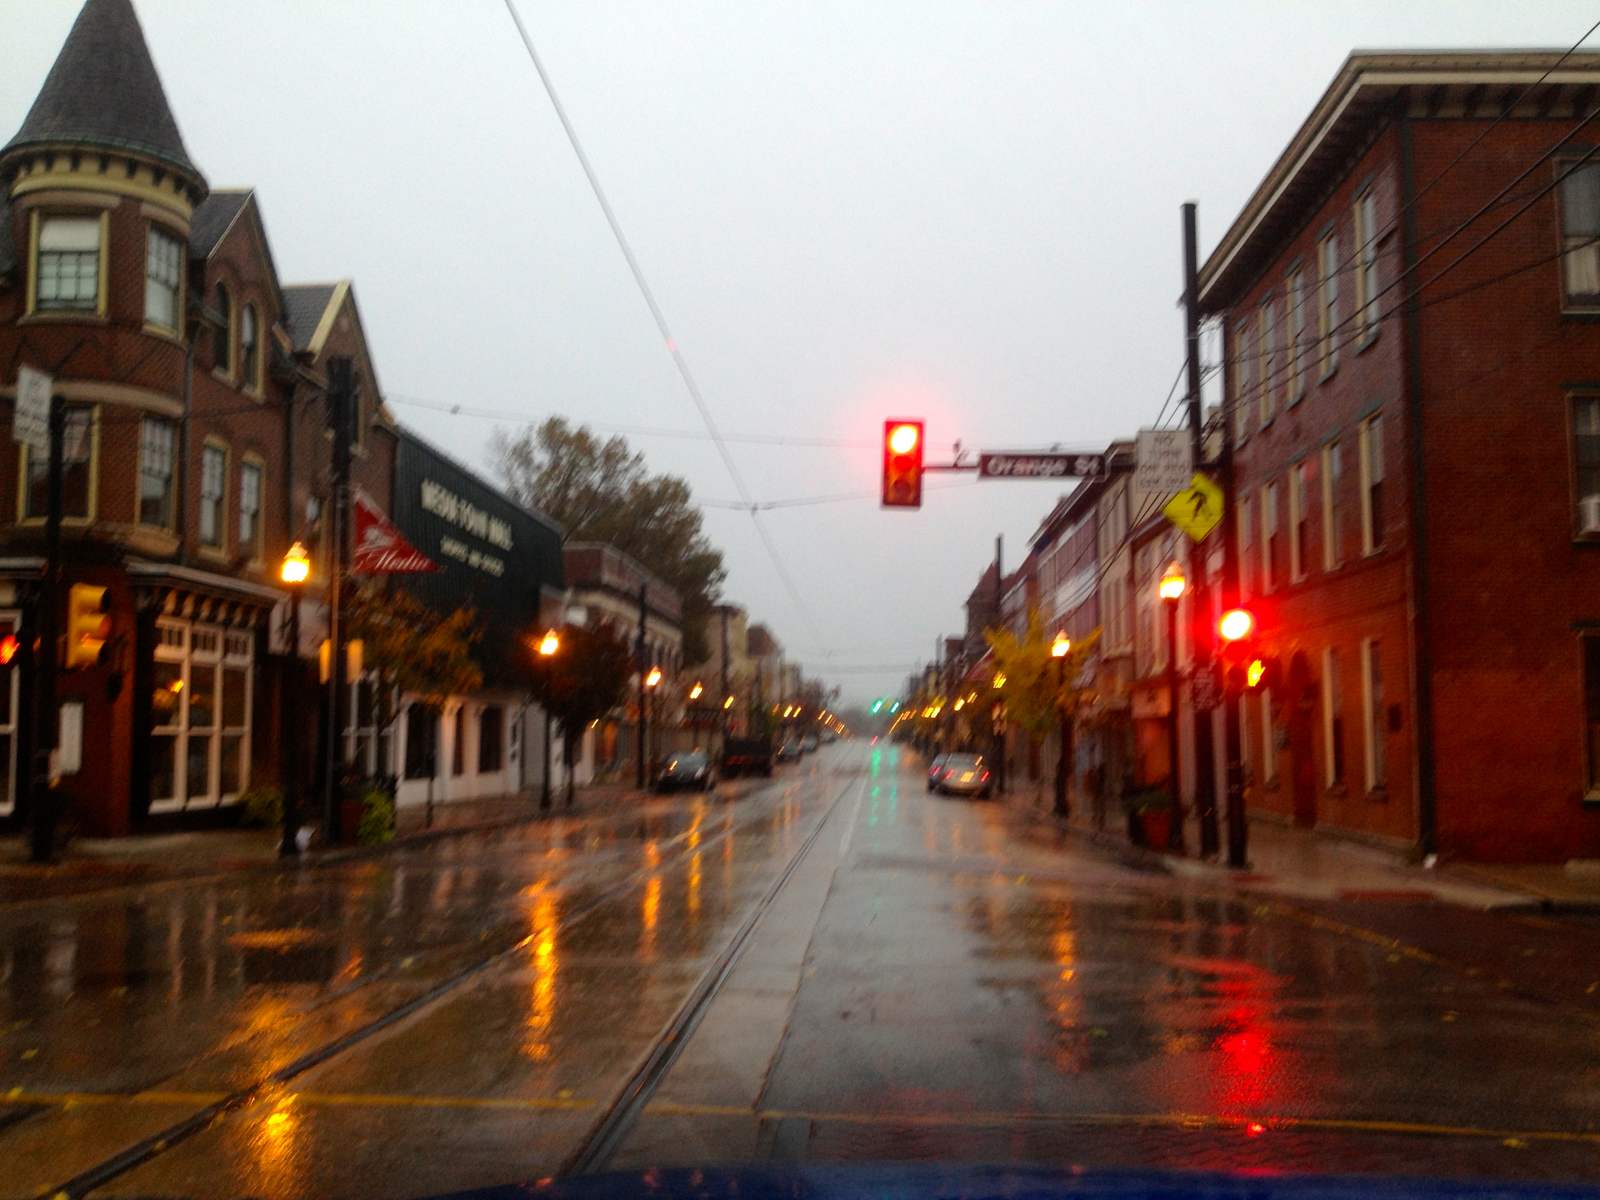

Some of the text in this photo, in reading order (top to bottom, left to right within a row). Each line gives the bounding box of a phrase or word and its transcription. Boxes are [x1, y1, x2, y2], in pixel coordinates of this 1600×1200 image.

[986, 455, 1101, 478] Orange St
[373, 549, 433, 571] Media
